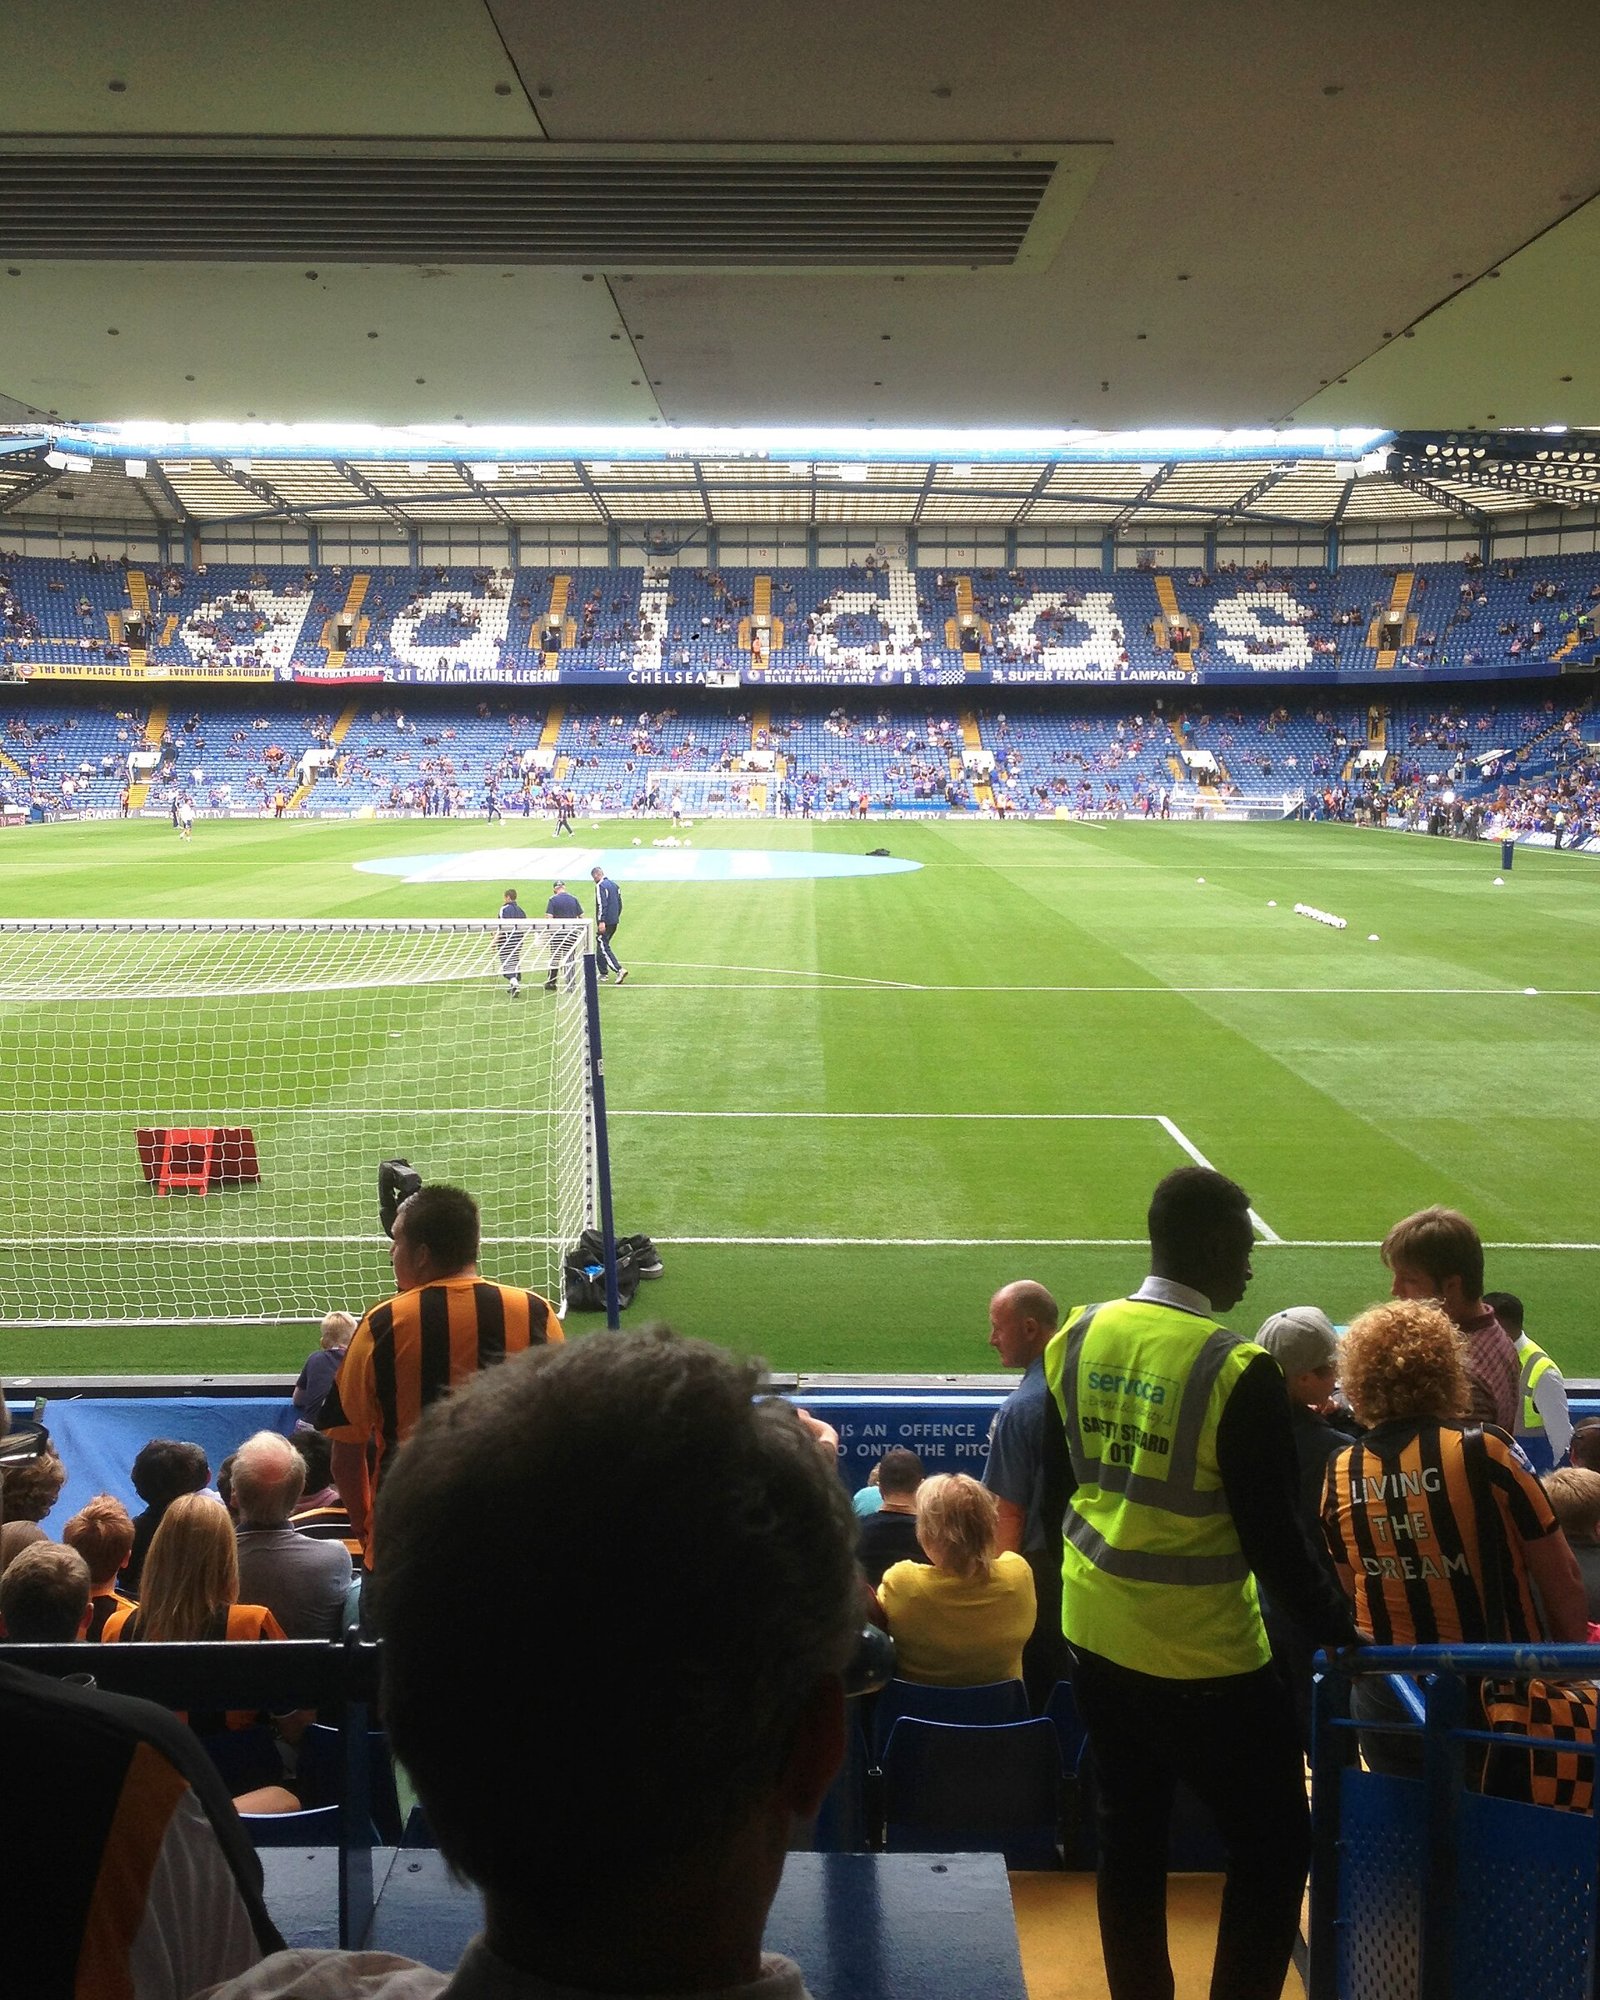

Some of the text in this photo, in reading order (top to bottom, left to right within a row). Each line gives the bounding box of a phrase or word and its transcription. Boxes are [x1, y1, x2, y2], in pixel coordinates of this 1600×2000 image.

[38, 666, 56, 674] THE
[60, 666, 82, 675] ONLY
[86, 667, 116, 676] PLACE
[121, 668, 131, 676] TO
[134, 669, 144, 677] BE
[169, 668, 196, 676] EVERY
[197, 668, 224, 677] OTHER
[226, 668, 271, 677] SATURDAY
[398, 669, 412, 681] JT
[628, 671, 706, 684] CHELSEA
[1008, 670, 1199, 685] SUPER FRANKIE LAMPARD 8
[764, 675, 875, 684] BLUE & WHITE ARMY
[841, 1424, 976, 1437] IS AN OFFENCE
[1082, 1416, 1169, 1455] SAETY STARD
[914, 1443, 946, 1456] THE
[955, 1443, 991, 1456] PITC
[1351, 1467, 1441, 1504] LIVING
[1372, 1512, 1429, 1542] THE
[1361, 1552, 1471, 1580] DREAM
